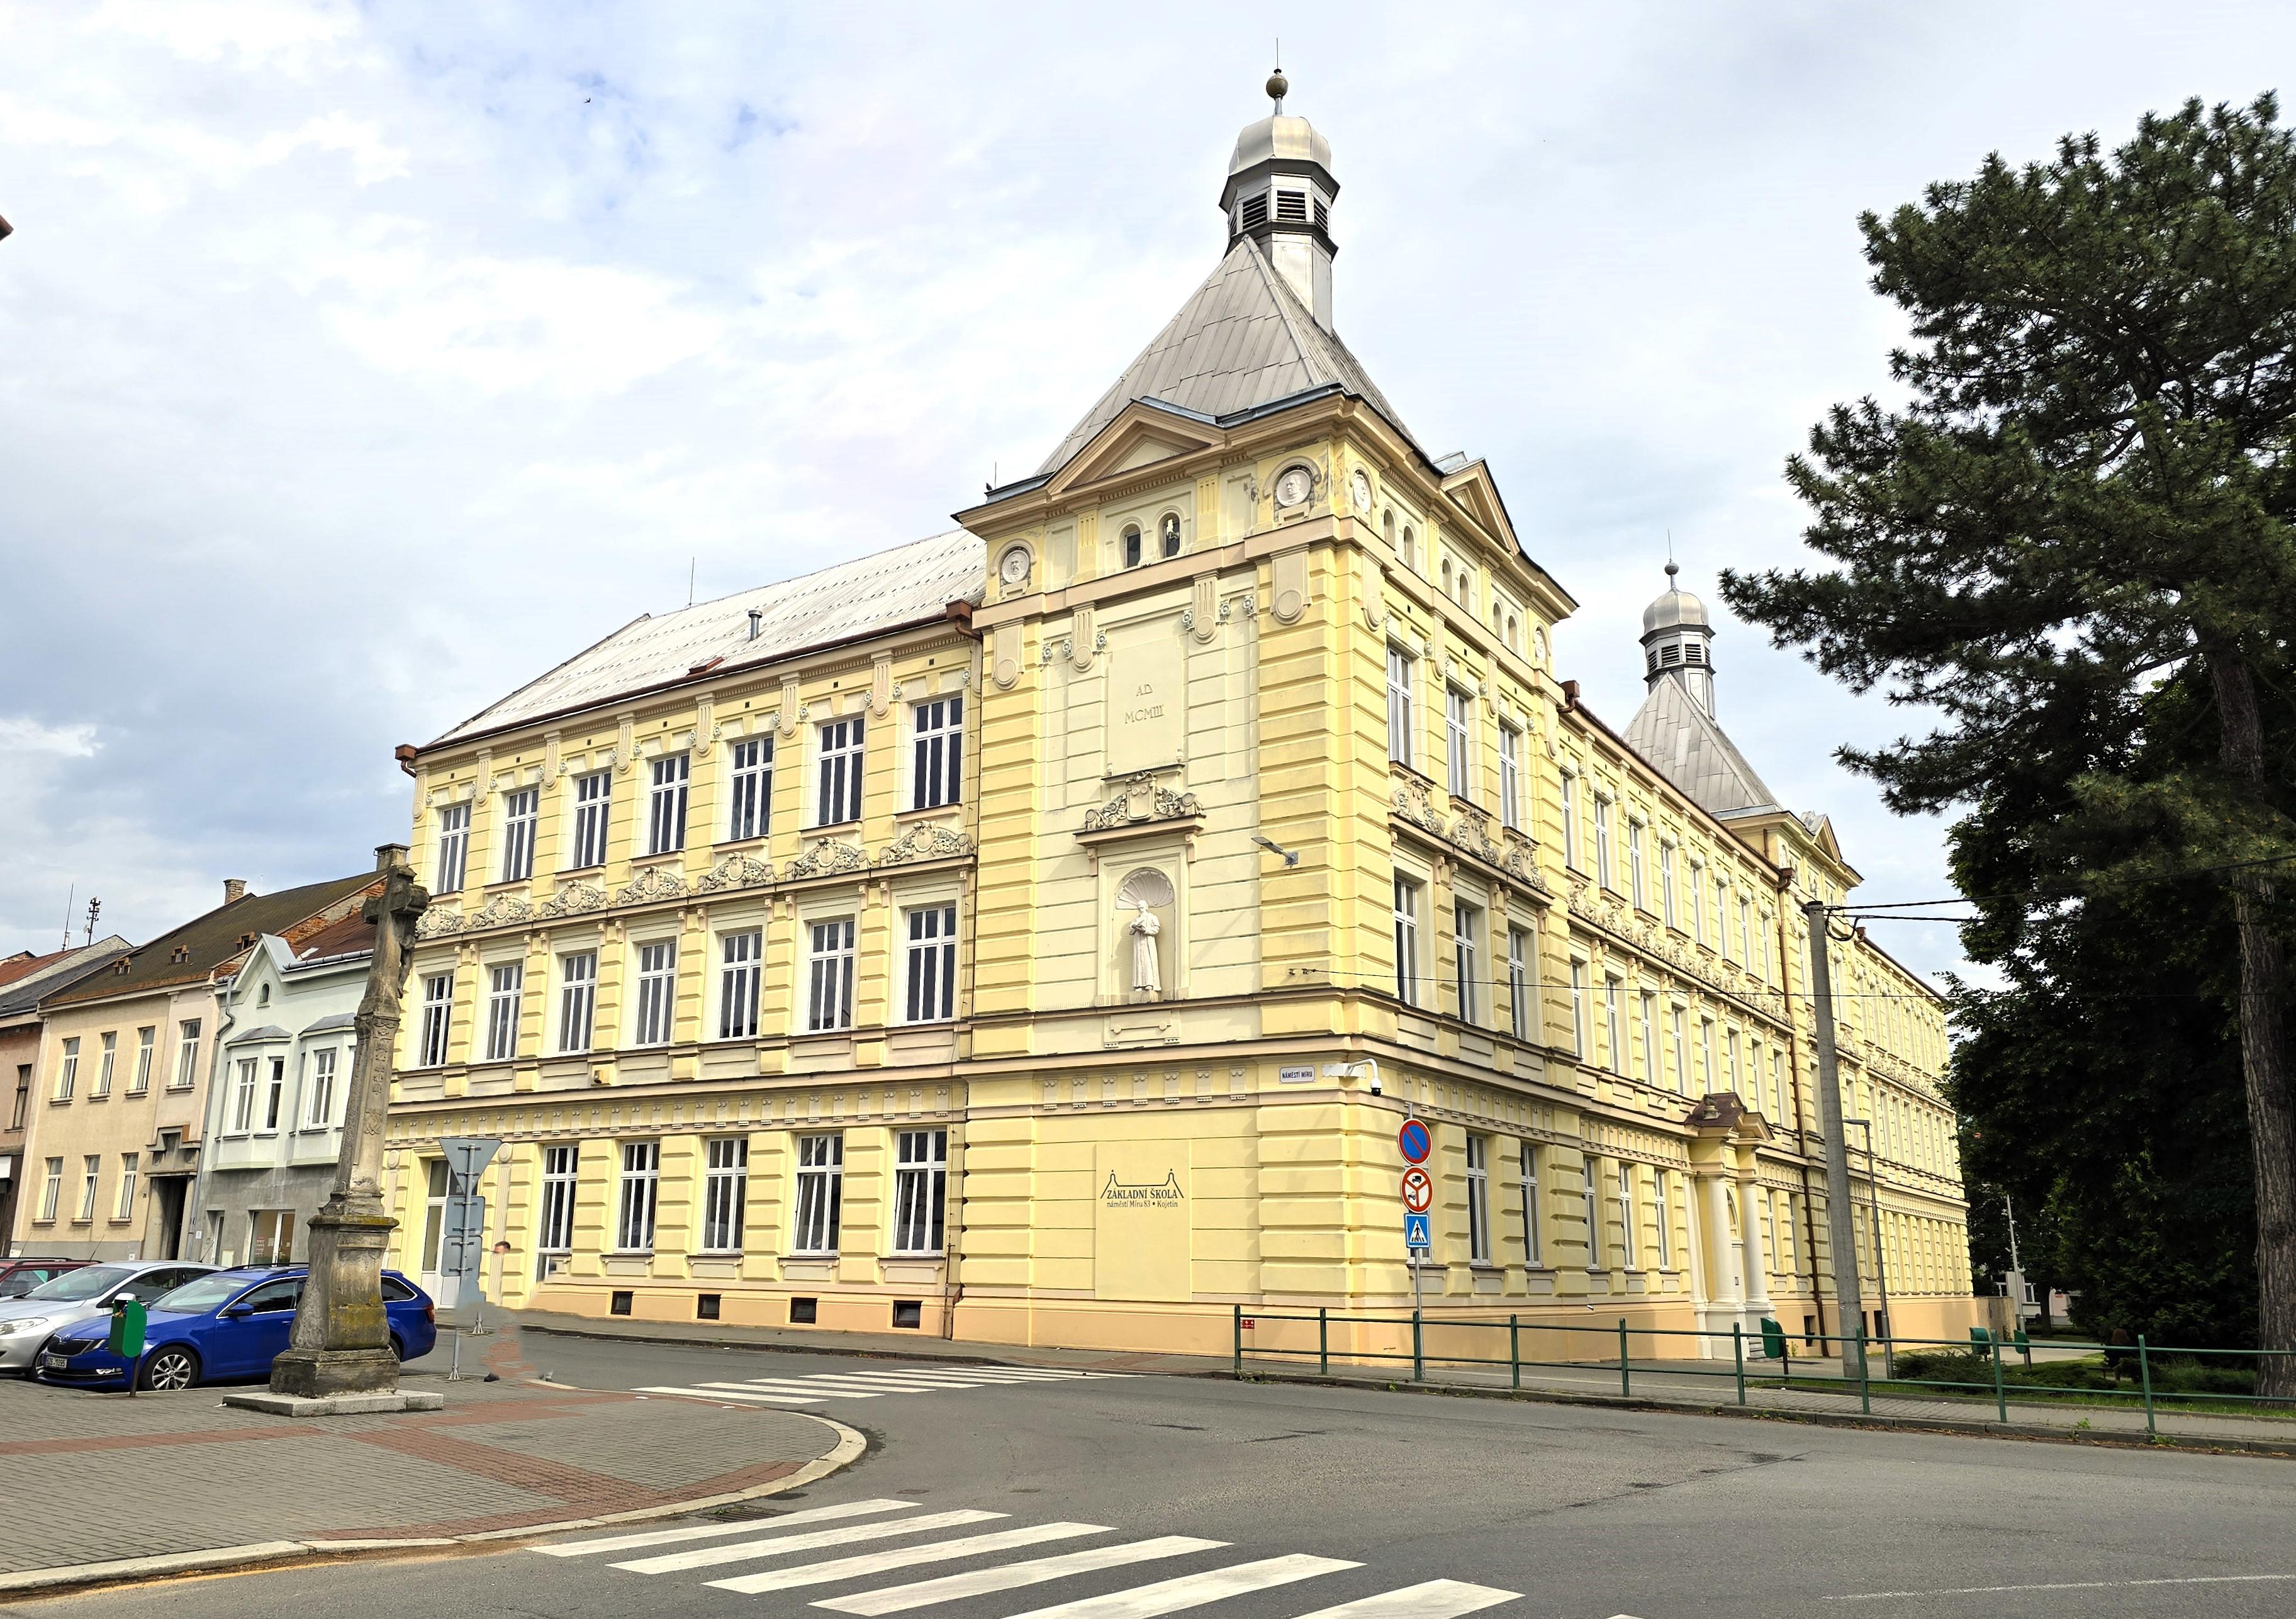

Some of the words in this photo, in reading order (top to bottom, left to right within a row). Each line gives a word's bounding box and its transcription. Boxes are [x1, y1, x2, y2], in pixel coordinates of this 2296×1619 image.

[1125, 705, 1164, 724] MCMIII
[1107, 1188, 1147, 1199] ZÁKLADNÍ
[1150, 1188, 1177, 1199] ŠKOLA
[1157, 1200, 1178, 1208] Kojetín
